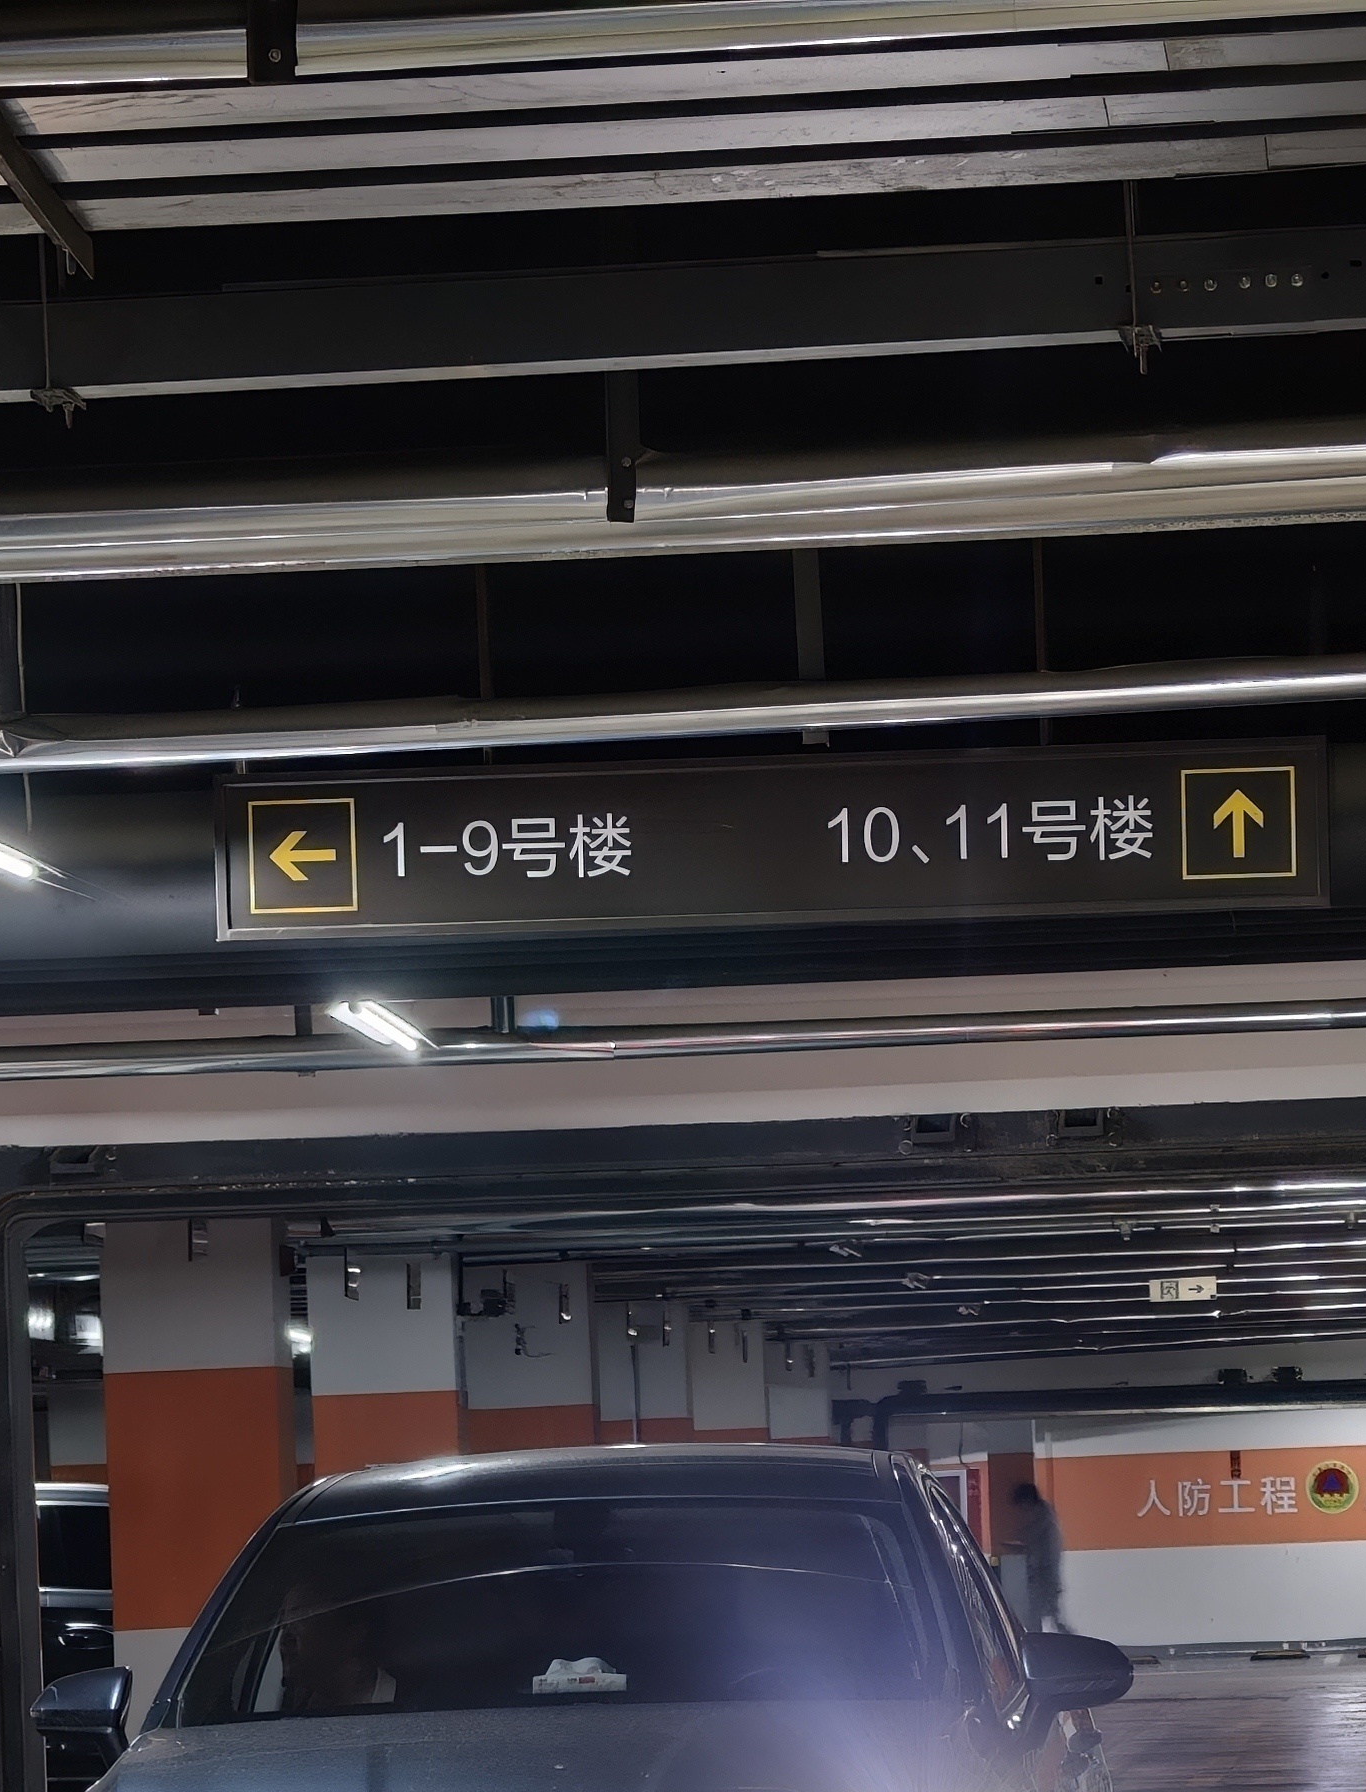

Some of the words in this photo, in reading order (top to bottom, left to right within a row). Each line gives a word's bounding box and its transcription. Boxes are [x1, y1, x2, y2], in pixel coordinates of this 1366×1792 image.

[381, 812, 634, 880] 1-9号楼
[827, 794, 1155, 866] 10、11号楼
[1137, 1476, 1298, 1518] 人防工程
